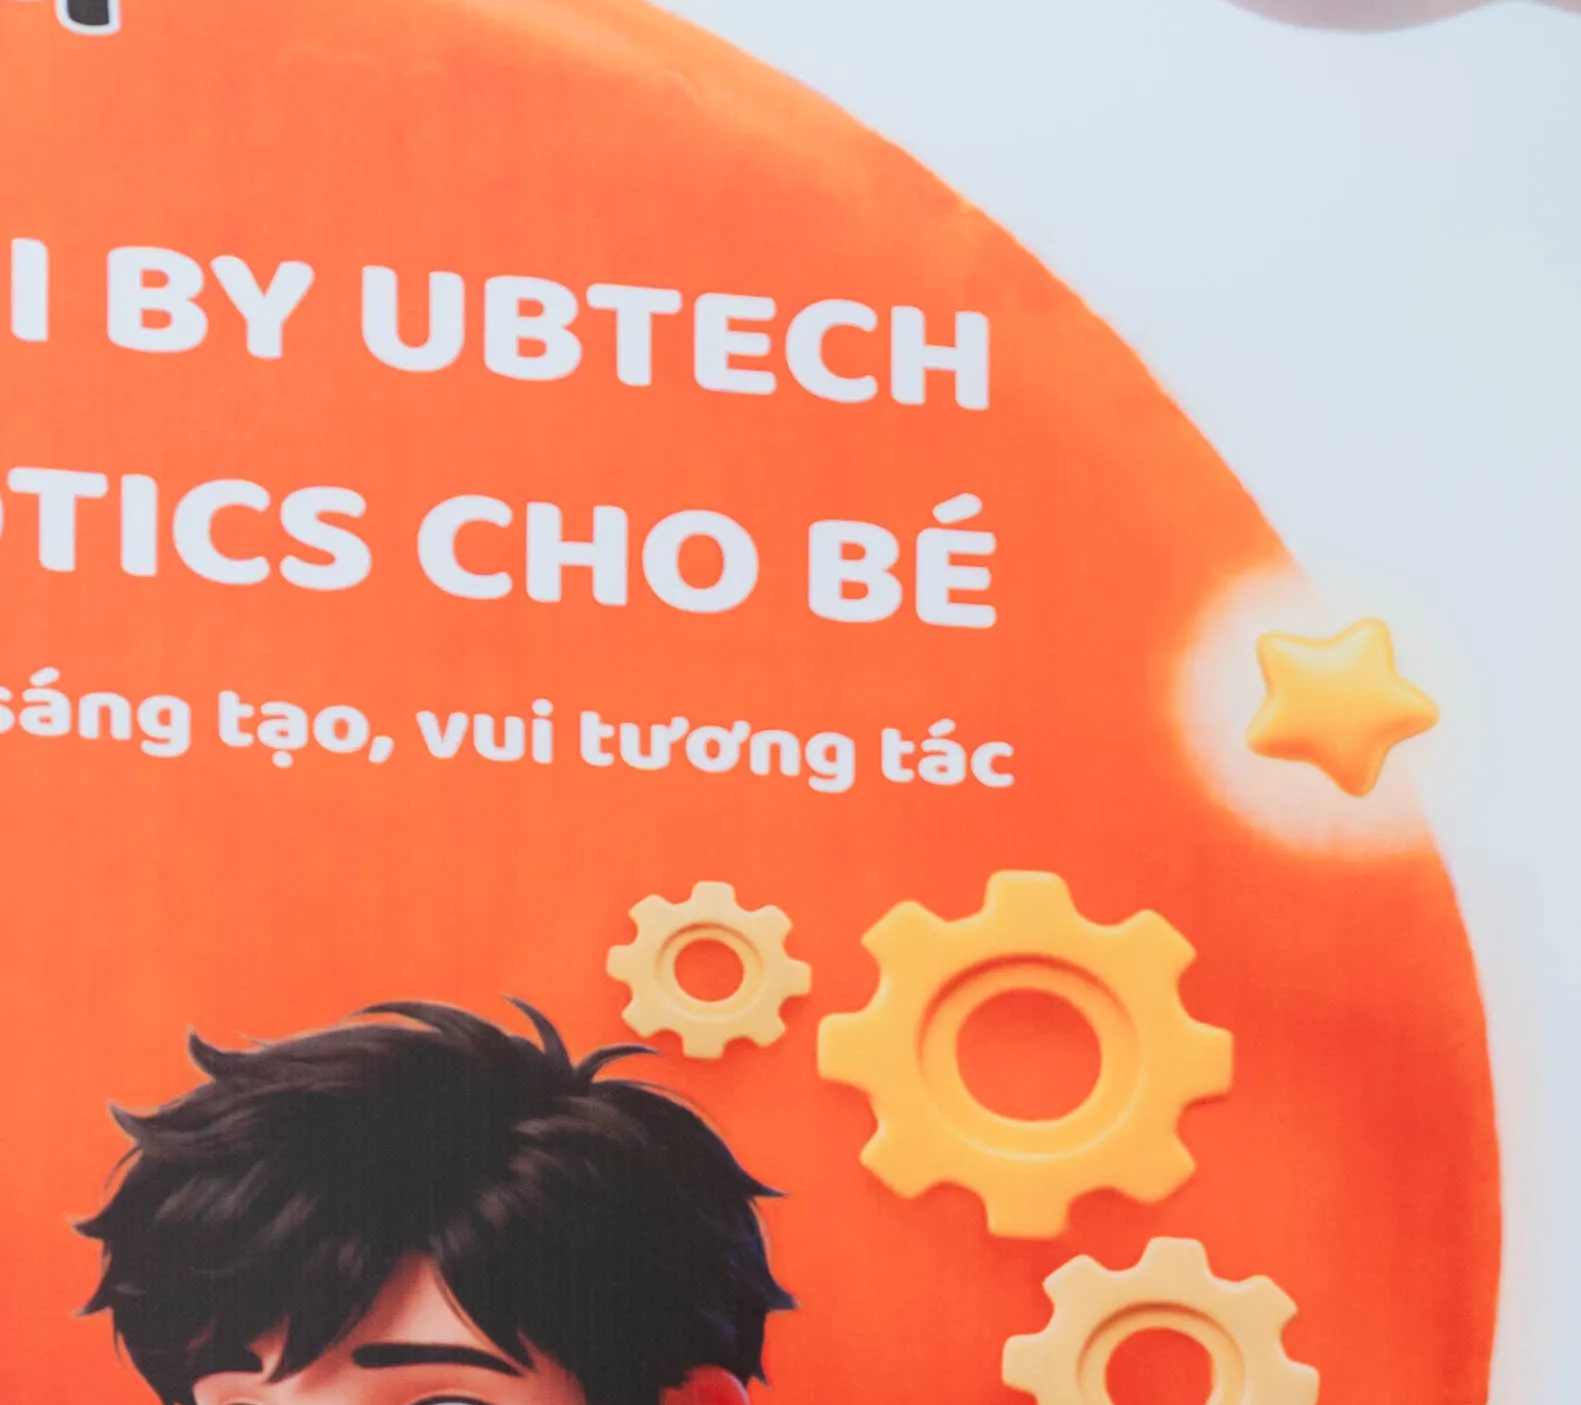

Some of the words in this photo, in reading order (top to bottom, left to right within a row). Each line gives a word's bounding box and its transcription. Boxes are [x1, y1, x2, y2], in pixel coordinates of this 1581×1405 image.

[106, 245, 314, 359] BY
[361, 264, 990, 411] UBTECH
[0, 466, 372, 591] TICS
[417, 494, 760, 613] CHO
[806, 492, 997, 628] BÉ
[217, 690, 394, 767] tạo,
[416, 697, 554, 763] vui
[579, 709, 856, 793] tương
[880, 718, 1015, 788] tác
